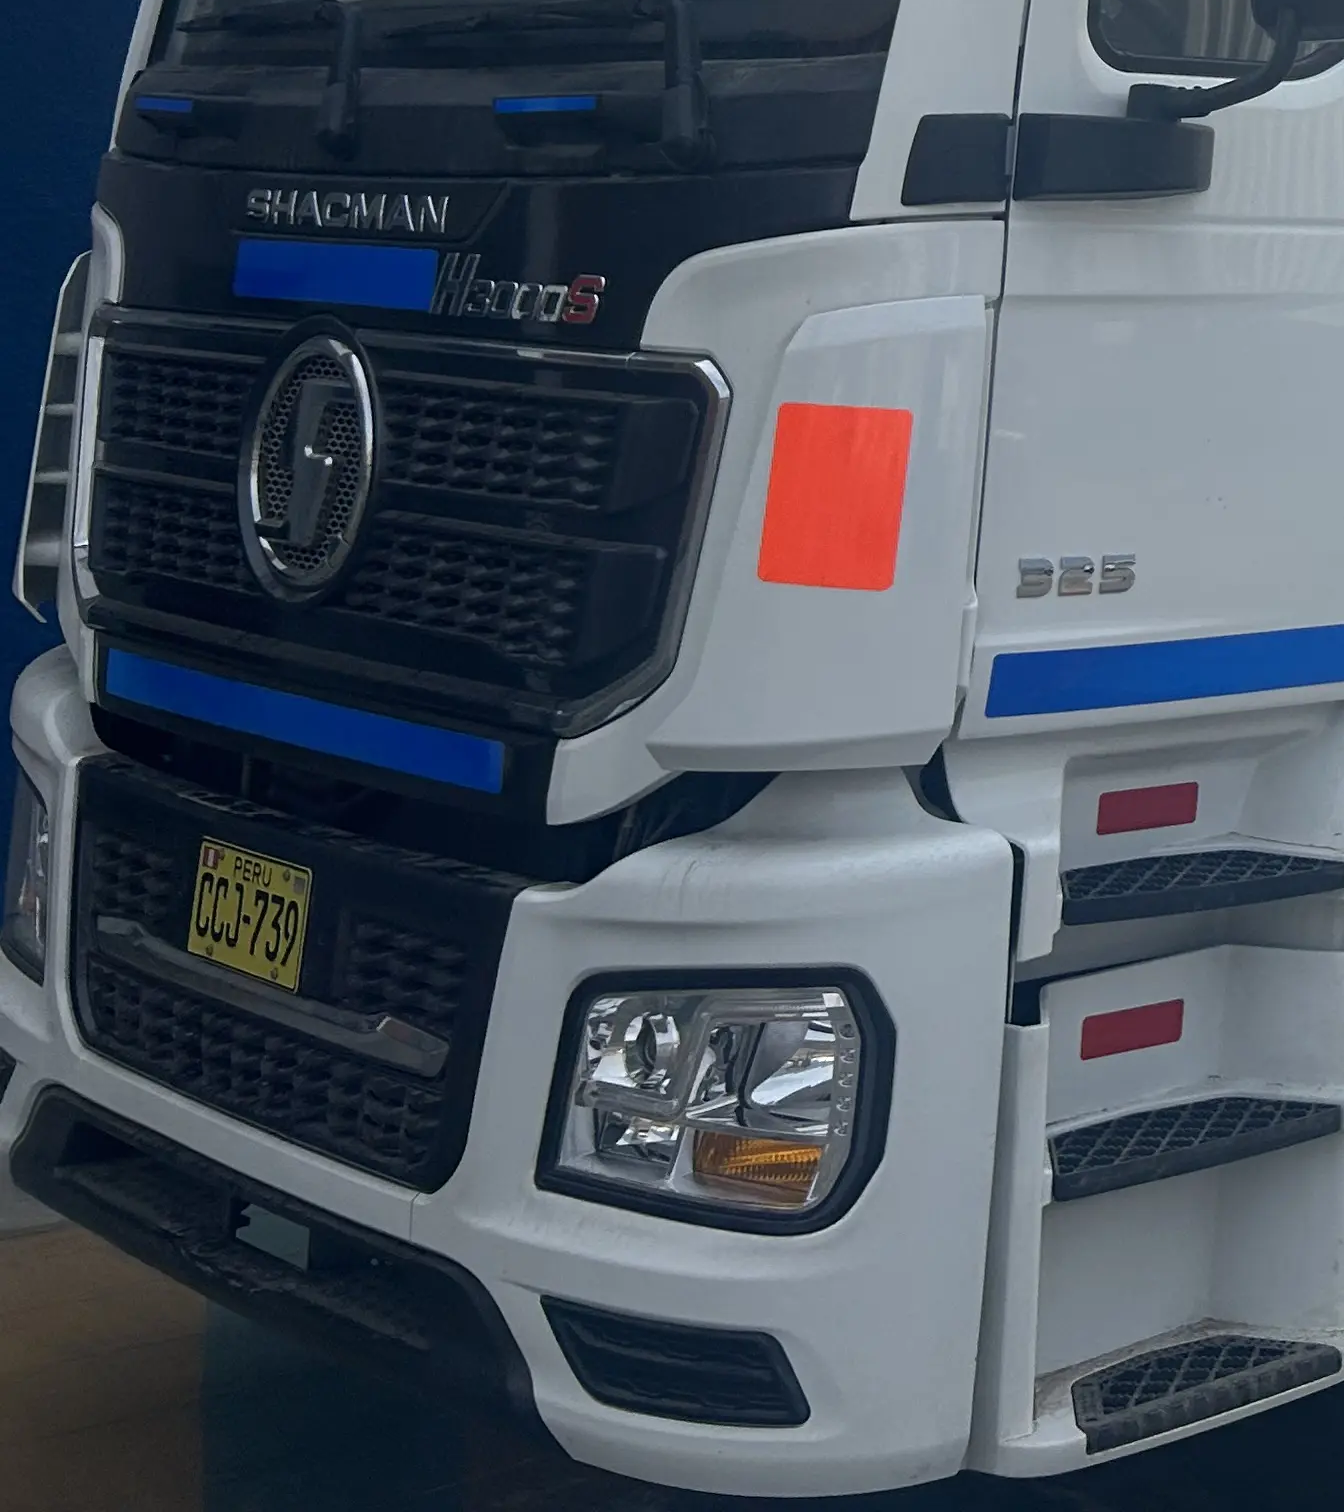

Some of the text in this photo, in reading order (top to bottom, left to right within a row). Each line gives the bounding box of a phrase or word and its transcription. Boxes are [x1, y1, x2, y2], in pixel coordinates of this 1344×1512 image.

[246, 188, 450, 234] SHACMAN
[431, 252, 605, 325] H3000S
[233, 856, 273, 888] PERU
[196, 872, 299, 967] CCJ-739
